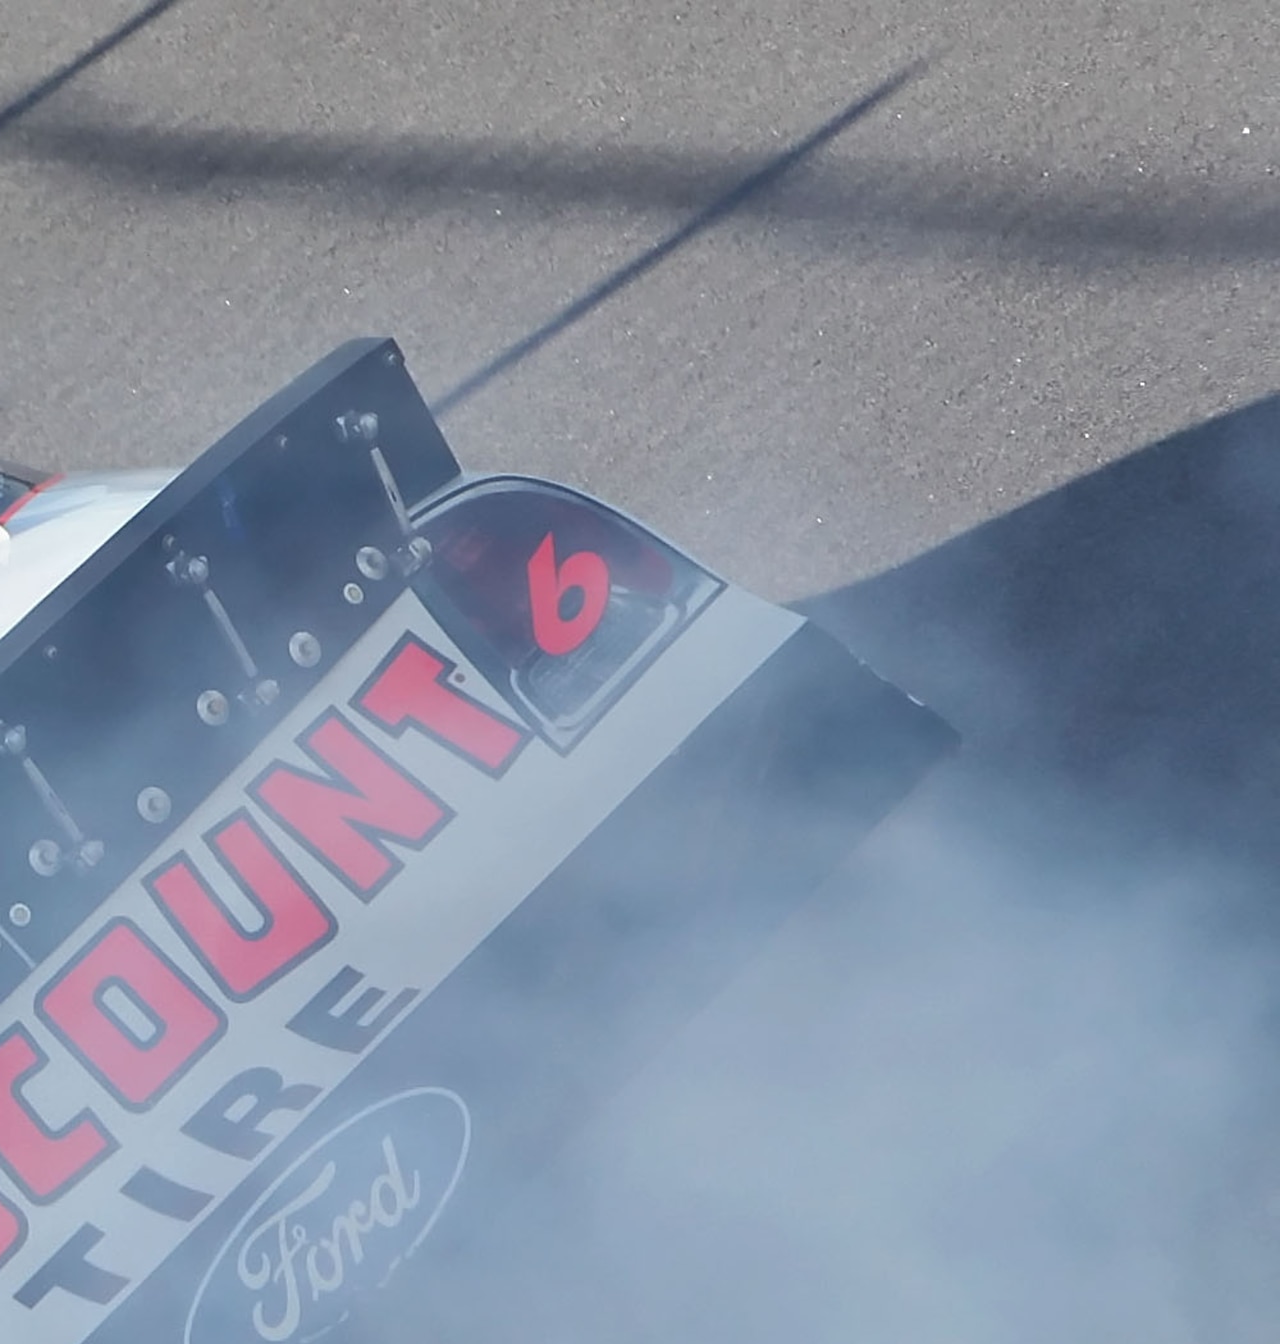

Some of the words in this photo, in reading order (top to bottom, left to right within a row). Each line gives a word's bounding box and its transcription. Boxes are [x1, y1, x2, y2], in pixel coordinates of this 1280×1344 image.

[528, 531, 610, 656] 6
[14, 964, 420, 1310] TIRE
[237, 1134, 421, 1341] Ford
